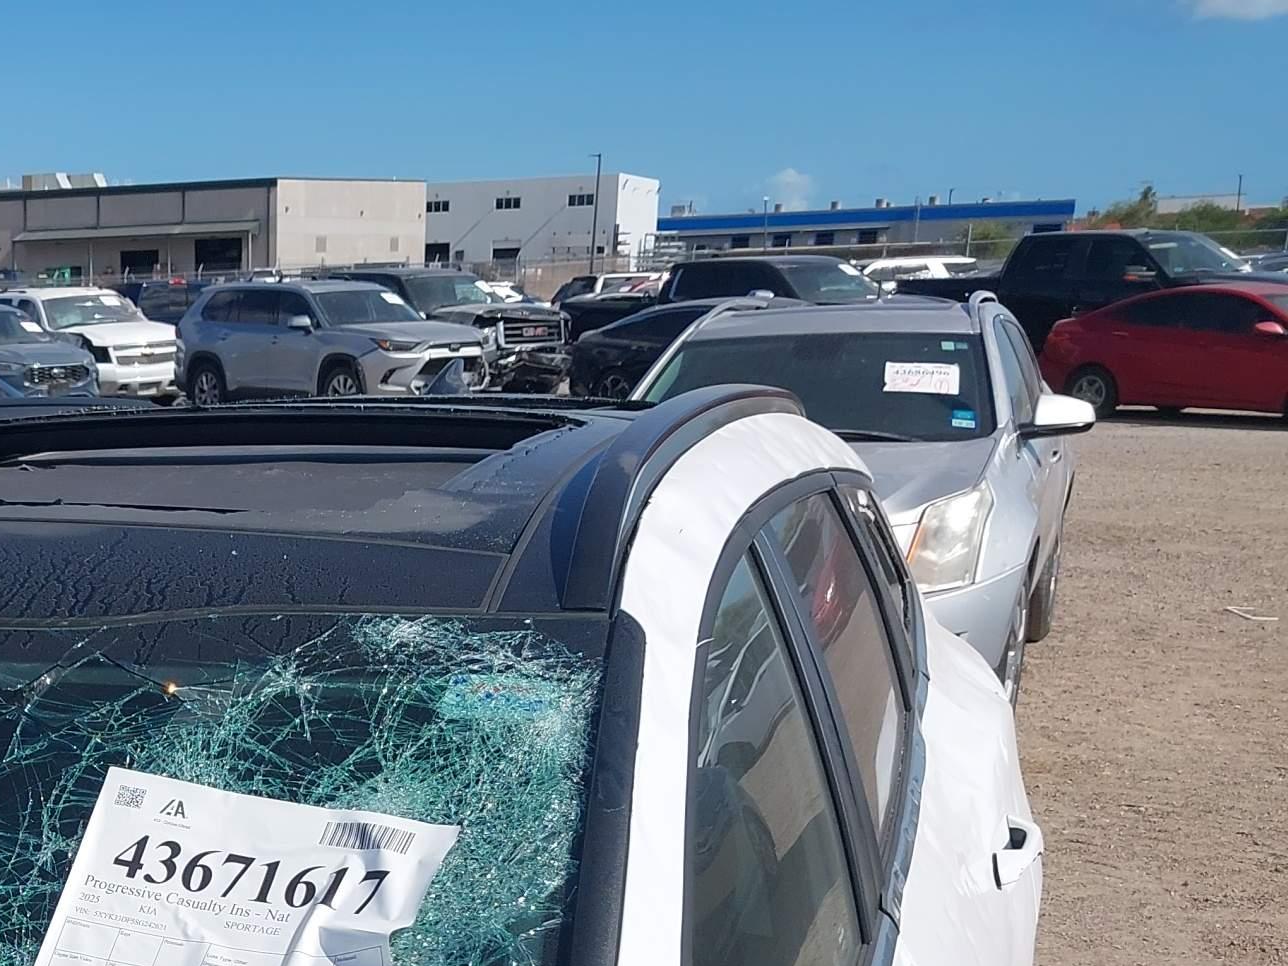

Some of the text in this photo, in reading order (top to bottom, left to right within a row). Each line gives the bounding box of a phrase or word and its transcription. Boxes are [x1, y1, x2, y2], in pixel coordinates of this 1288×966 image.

[112, 834, 391, 915] 43671617
[79, 891, 101, 904] 2025
[83, 875, 162, 902] Progressive
[166, 892, 226, 916] Casualty
[230, 902, 253, 917] Ins
[265, 909, 291, 923] Nat
[138, 904, 158, 917] KIA
[223, 920, 281, 936] SPORTAGE
